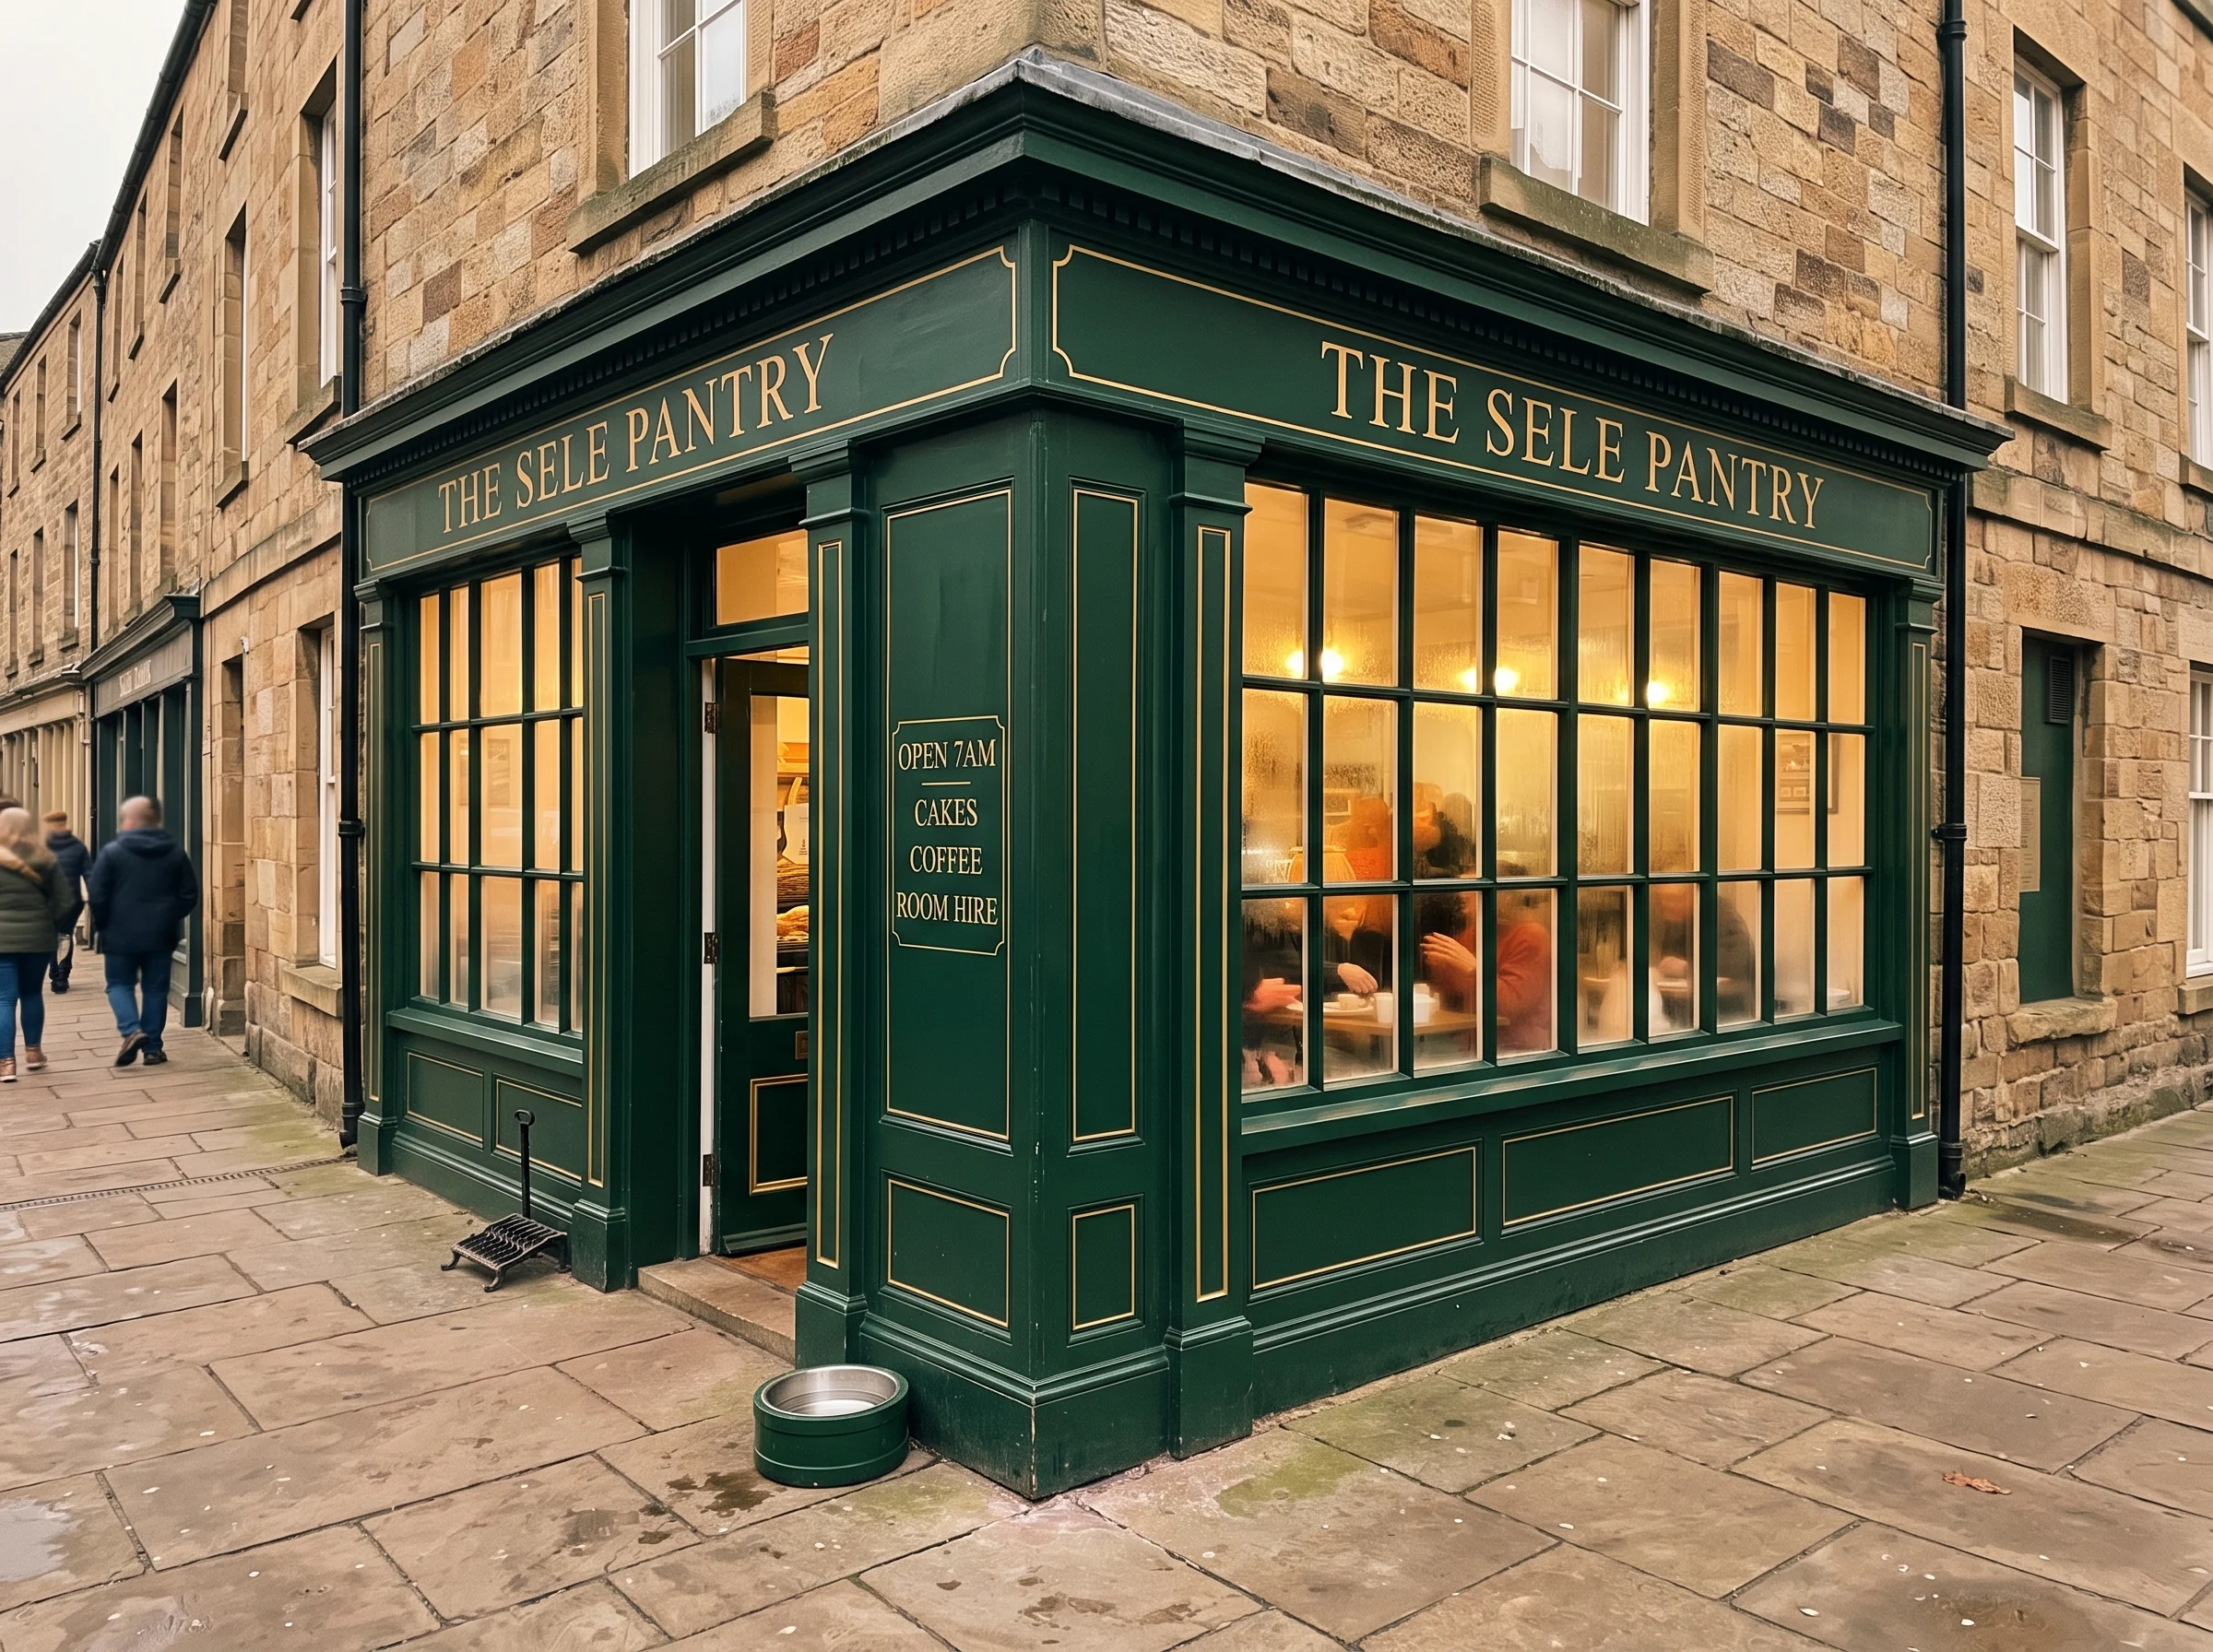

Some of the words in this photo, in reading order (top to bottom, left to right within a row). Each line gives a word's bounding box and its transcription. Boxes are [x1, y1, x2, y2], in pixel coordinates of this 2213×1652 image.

[438, 463, 503, 534] THE
[515, 420, 610, 510] SELE
[625, 333, 834, 473] PANTRY
[1321, 340, 1460, 444] THE
[1486, 388, 1625, 483] SELE
[1644, 431, 1825, 529] PANTRY
[897, 740, 949, 771] OPEN
[953, 738, 997, 769] 7AM
[914, 797, 978, 827] CAKES
[909, 845, 983, 875] COFFEE
[895, 891, 950, 922] ROOM
[953, 895, 999, 926] HIRE
